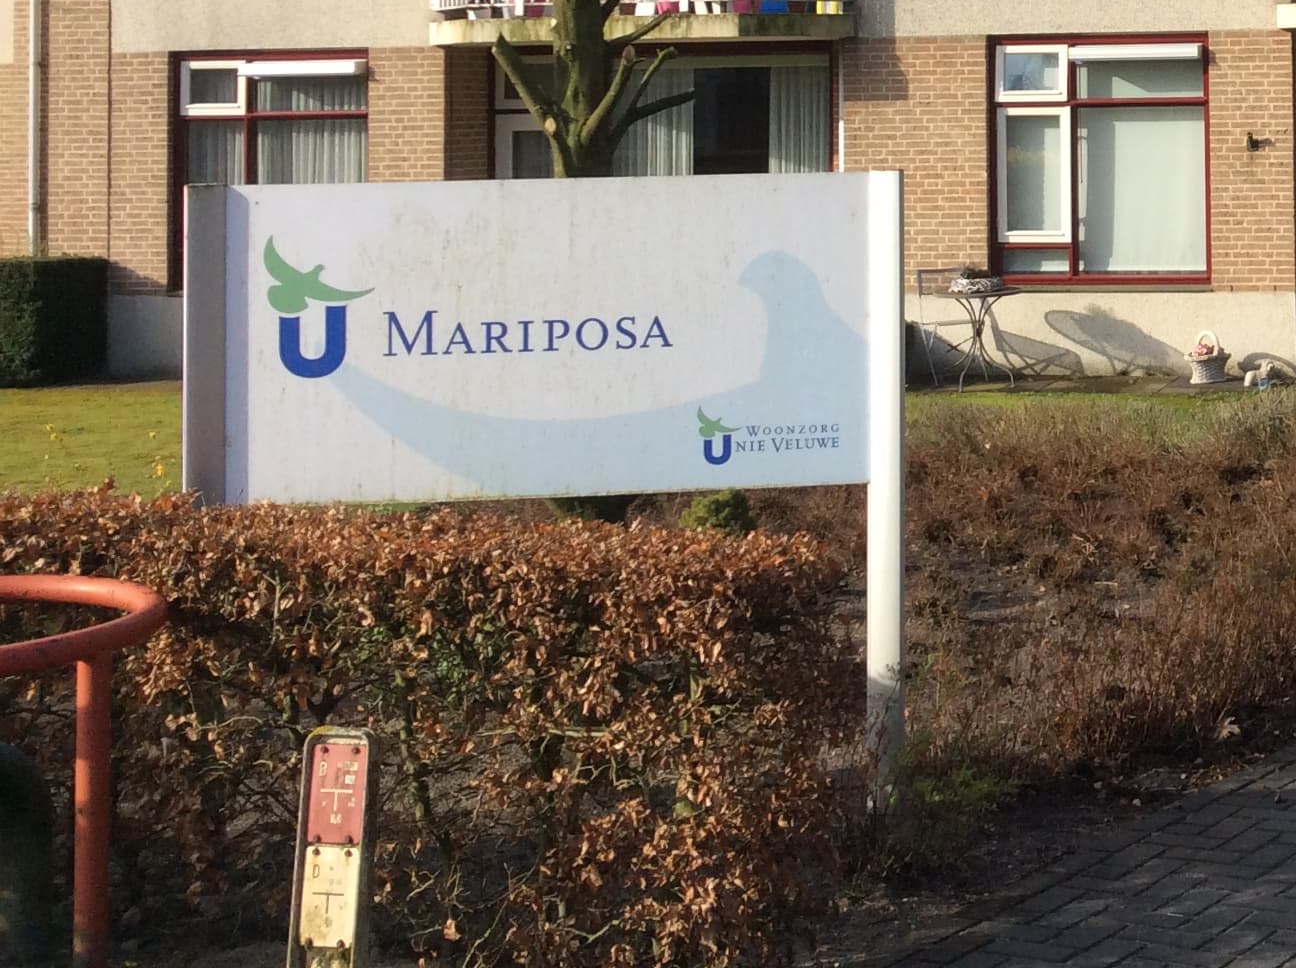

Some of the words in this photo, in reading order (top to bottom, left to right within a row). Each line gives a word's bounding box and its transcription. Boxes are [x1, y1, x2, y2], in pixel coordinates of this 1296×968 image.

[382, 309, 674, 357] MARIPOSA
[746, 423, 840, 438] WOONZORG
[771, 436, 840, 453] VELUWE
